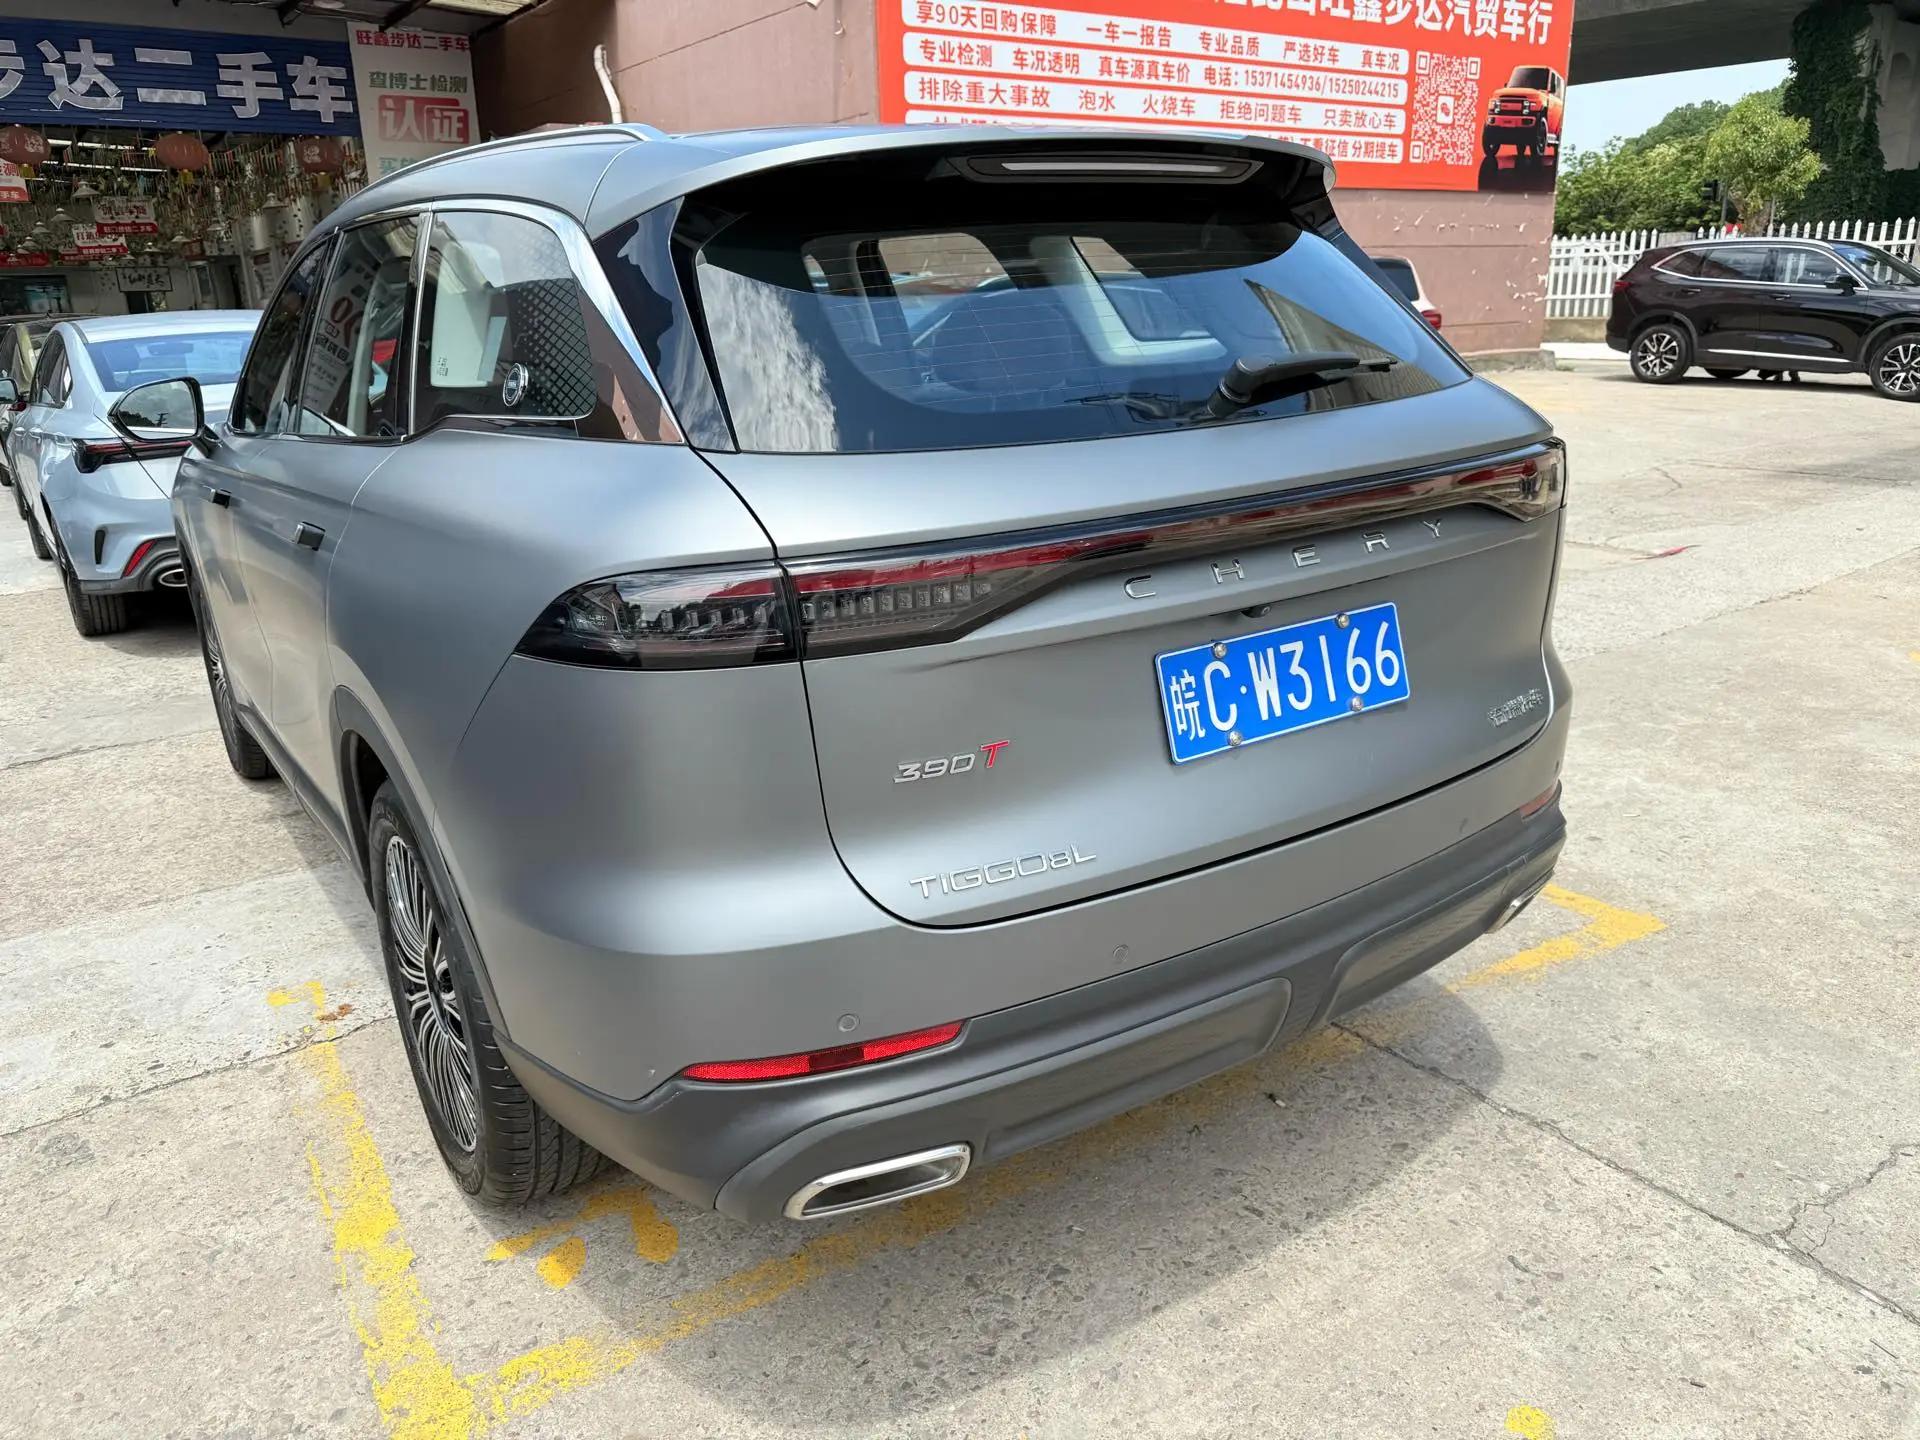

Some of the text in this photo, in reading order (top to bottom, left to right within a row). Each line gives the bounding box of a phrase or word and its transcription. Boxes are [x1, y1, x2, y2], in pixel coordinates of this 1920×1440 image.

[356, 30, 470, 51] 旺鑫步达二手车
[916, 0, 1400, 71] 享90天回购保障 一车一报告 专业品质 严选好车 真车况
[1213, 0, 1552, 45] 鑫步达汽贸车行
[368, 71, 468, 93] 查博士检测
[919, 39, 994, 67] 专业检测
[1012, 48, 1081, 74] 车况透明
[1098, 55, 1191, 83] 真车源真车价
[381, 97, 465, 144] 认证
[918, 76, 1397, 131] 排除重大事故 泡水 火烧车 拒绝问题车 只卖放心车
[1352, 138, 1399, 160] 分期提车
[1124, 519, 1442, 599] CHERY
[894, 740, 1011, 784] 390T
